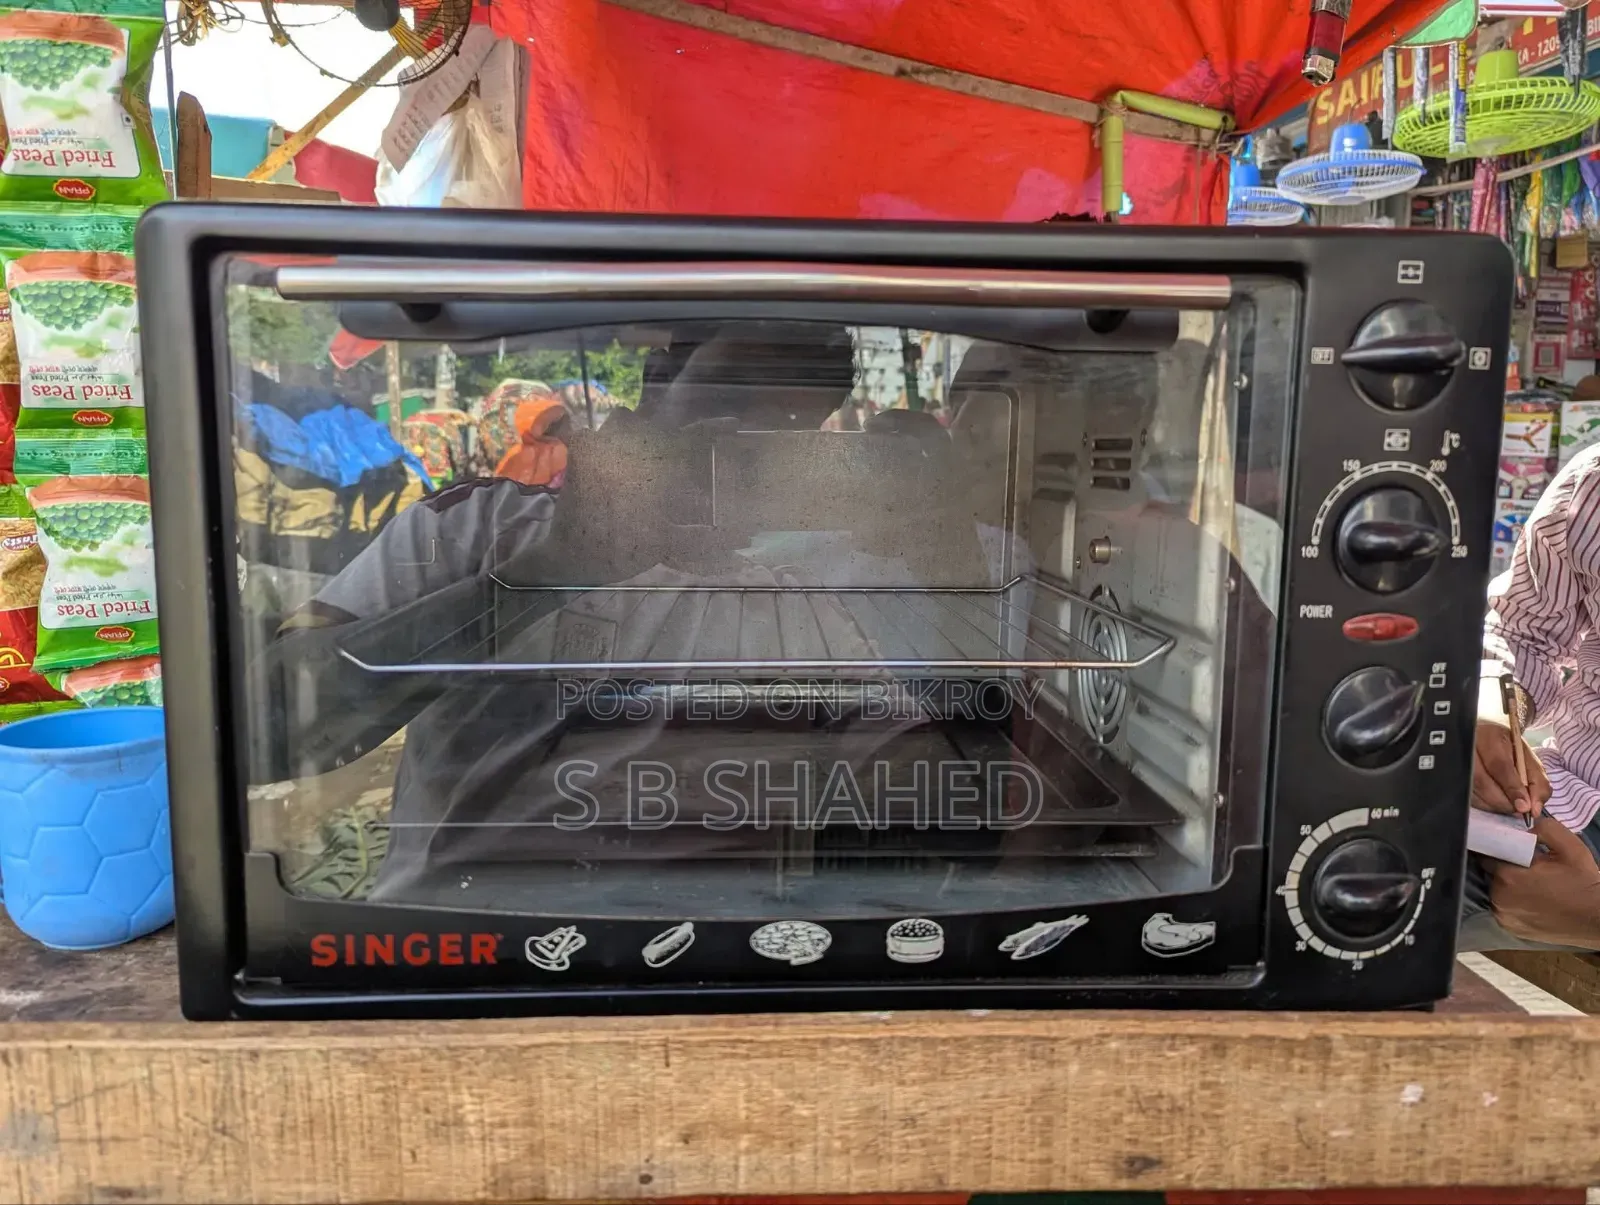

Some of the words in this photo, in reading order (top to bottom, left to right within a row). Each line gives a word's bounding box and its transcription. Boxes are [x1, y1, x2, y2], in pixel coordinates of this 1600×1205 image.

[13, 149, 58, 167] Peas
[61, 150, 116, 168] Fried
[58, 186, 91, 195] PRAN
[32, 385, 77, 401] Peas
[81, 385, 133, 400] Fried
[1342, 459, 1361, 472] 150
[1429, 459, 1447, 472] 200
[2, 534, 38, 547] Tasty
[1301, 545, 1319, 558] 100
[1451, 545, 1468, 558] 250
[56, 603, 99, 619] Peas
[102, 600, 151, 618] Fried
[1299, 605, 1333, 618] POWER
[99, 630, 130, 639] PRAN
[1431, 662, 1447, 673] OFF
[1371, 808, 1382, 819] 60
[1383, 806, 1400, 817] min
[1300, 825, 1312, 836] 50
[1421, 867, 1436, 879] OFF
[1295, 940, 1307, 951] 30
[1404, 934, 1415, 946] 10
[309, 932, 499, 967] SINGER
[1352, 960, 1363, 970] 20
